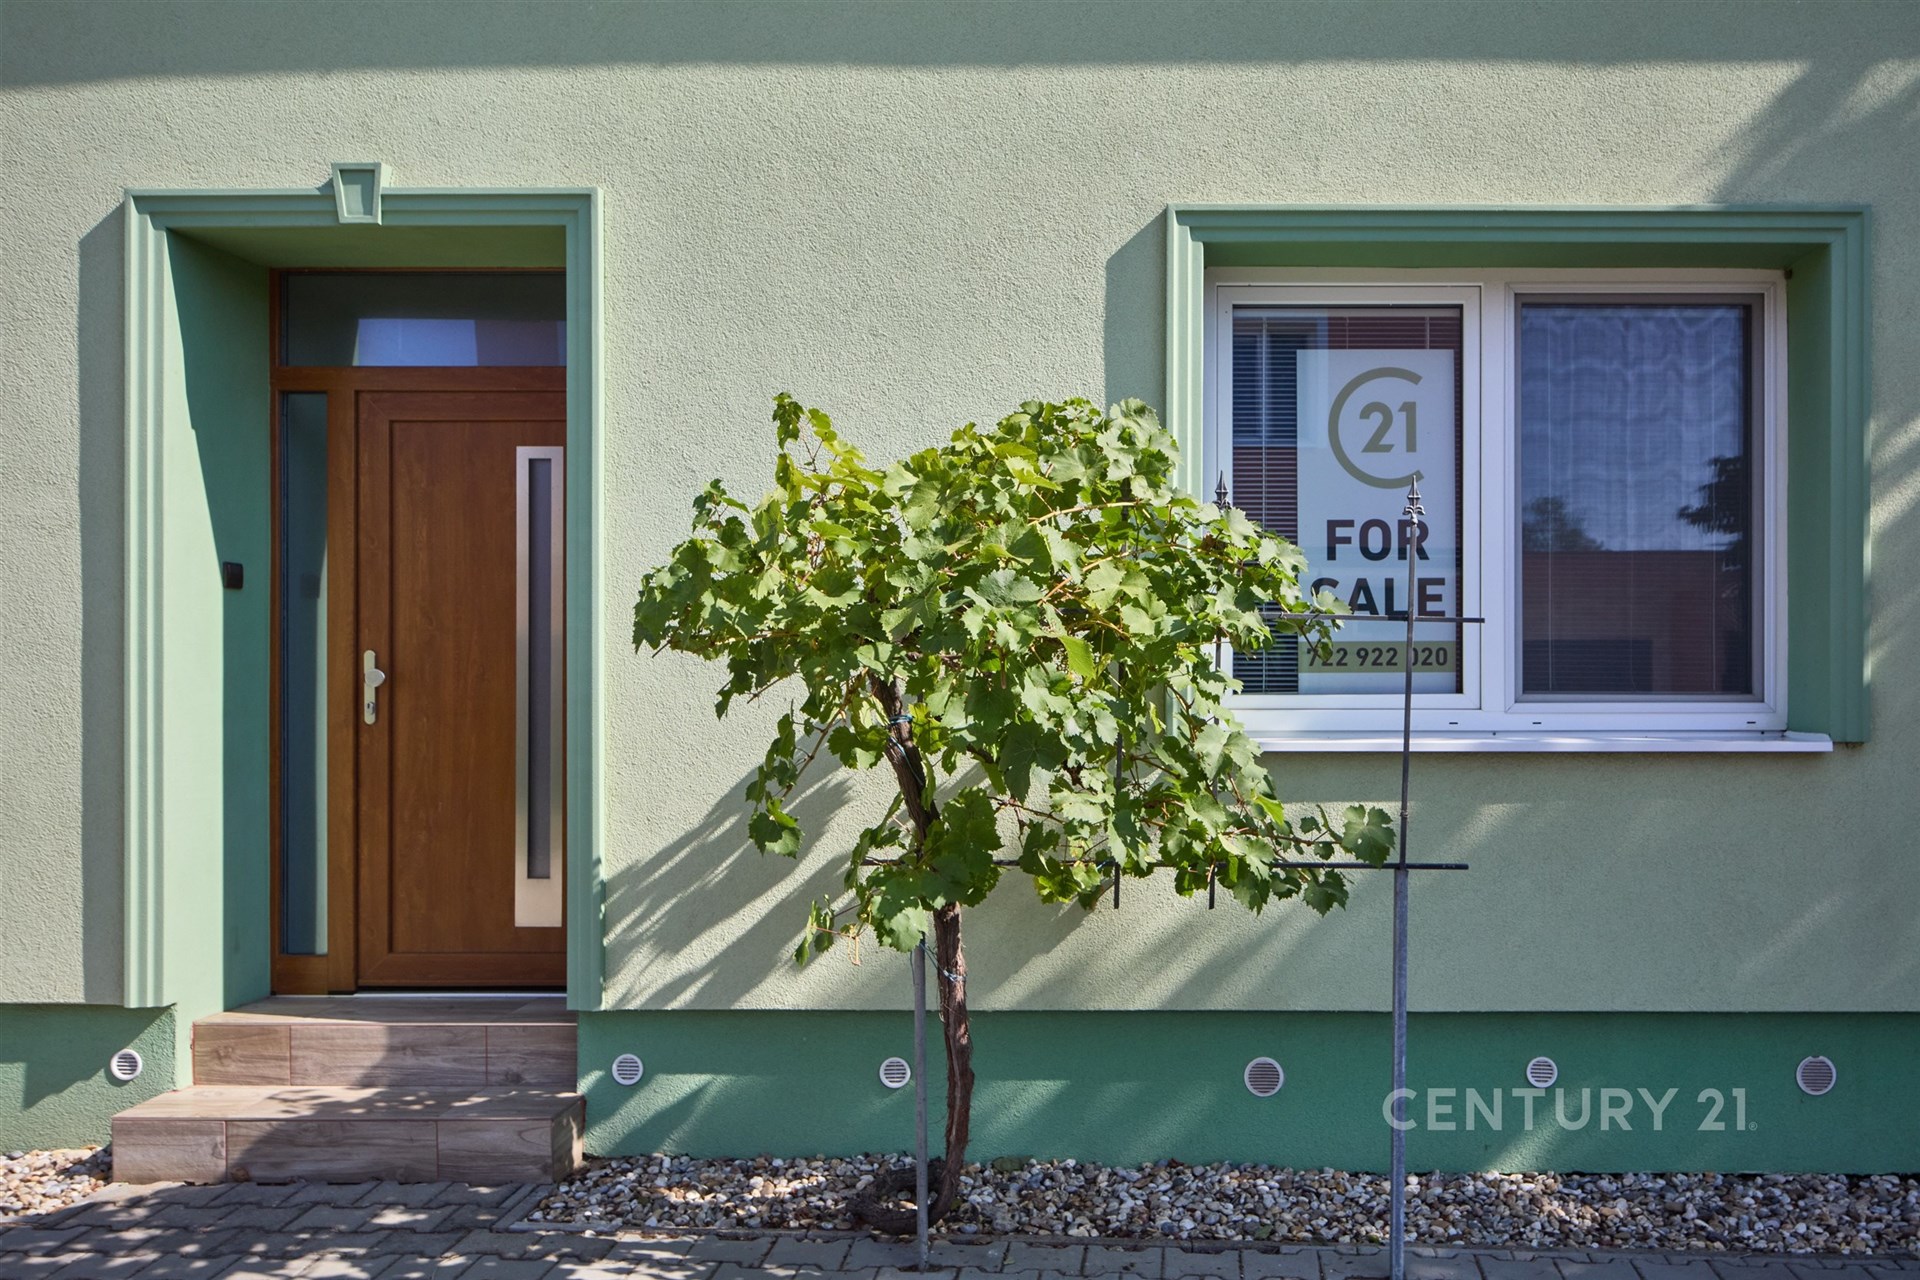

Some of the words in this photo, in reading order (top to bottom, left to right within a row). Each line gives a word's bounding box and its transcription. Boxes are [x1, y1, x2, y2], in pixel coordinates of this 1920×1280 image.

[1359, 402, 1417, 453] 21
[1326, 518, 1430, 561] FOR
[1356, 647, 1398, 667] 922
